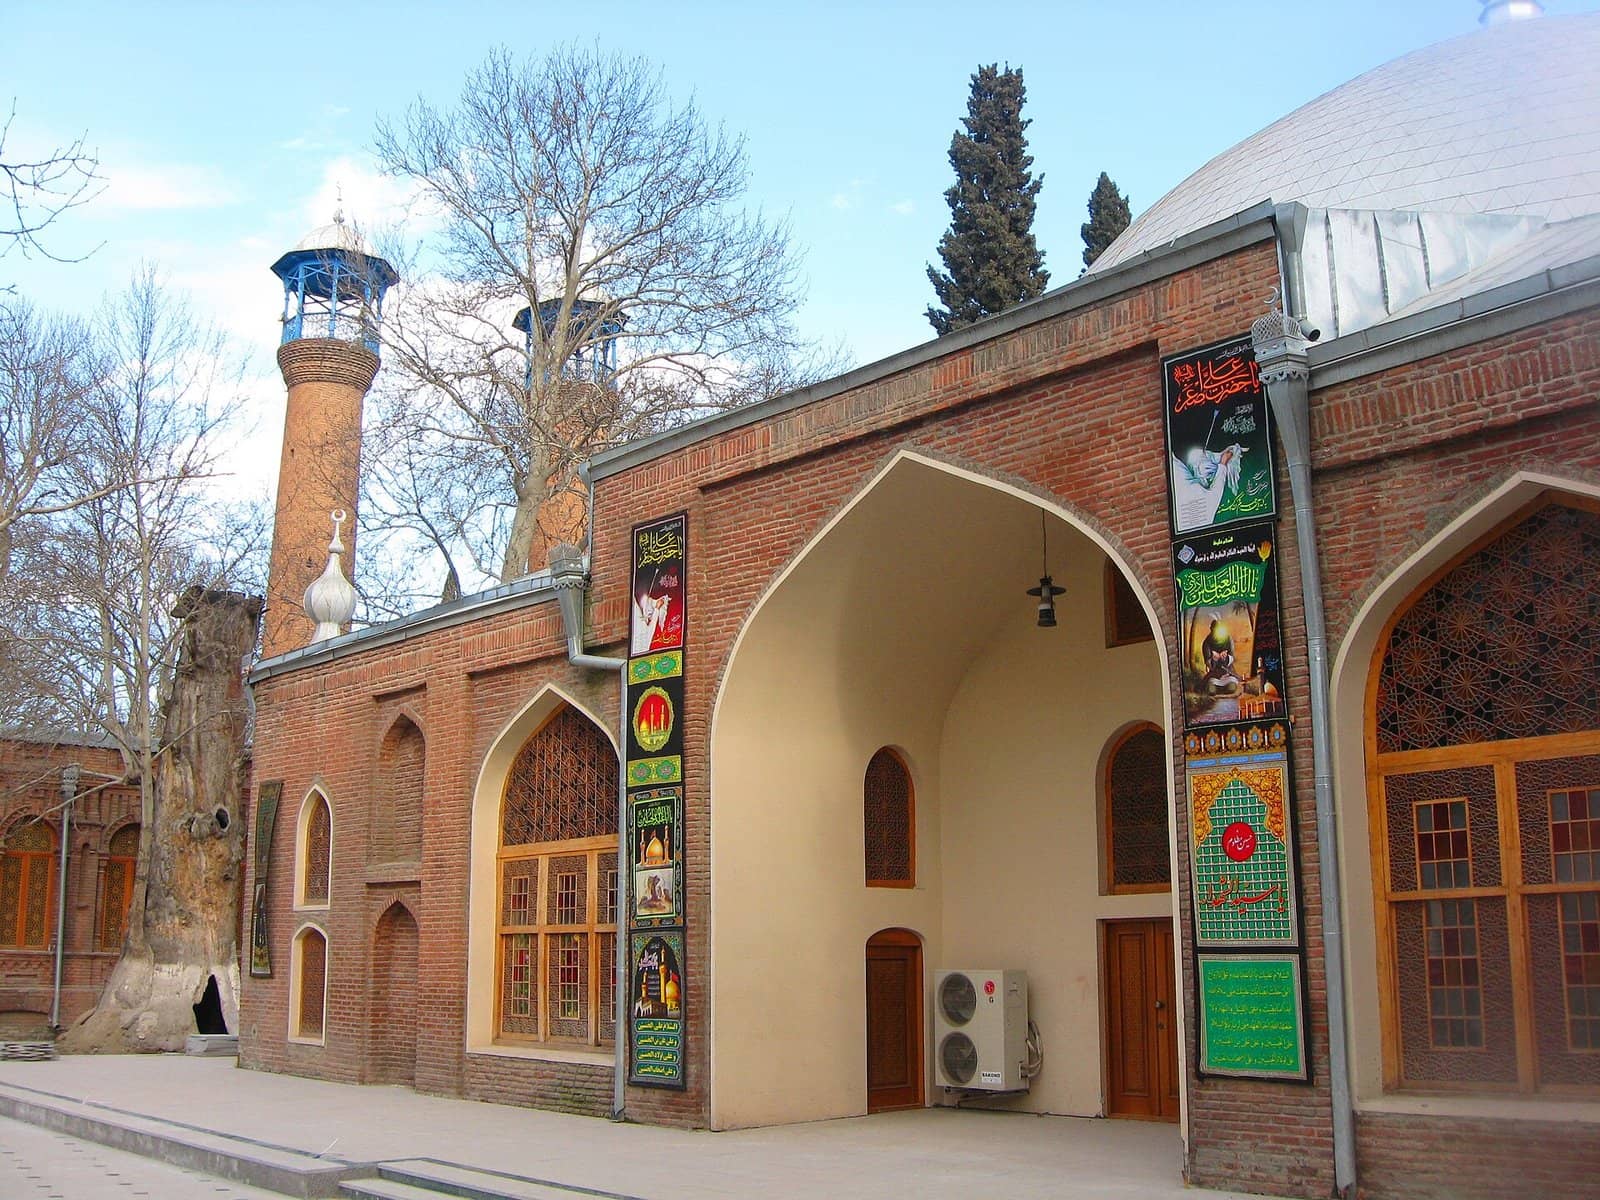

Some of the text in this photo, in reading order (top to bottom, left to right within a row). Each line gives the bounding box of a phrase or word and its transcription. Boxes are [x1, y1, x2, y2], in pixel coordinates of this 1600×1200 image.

[1249, 361, 1259, 393] یا
[1206, 380, 1252, 403] حضرت
[1226, 829, 1253, 853] حسین مظلوم
